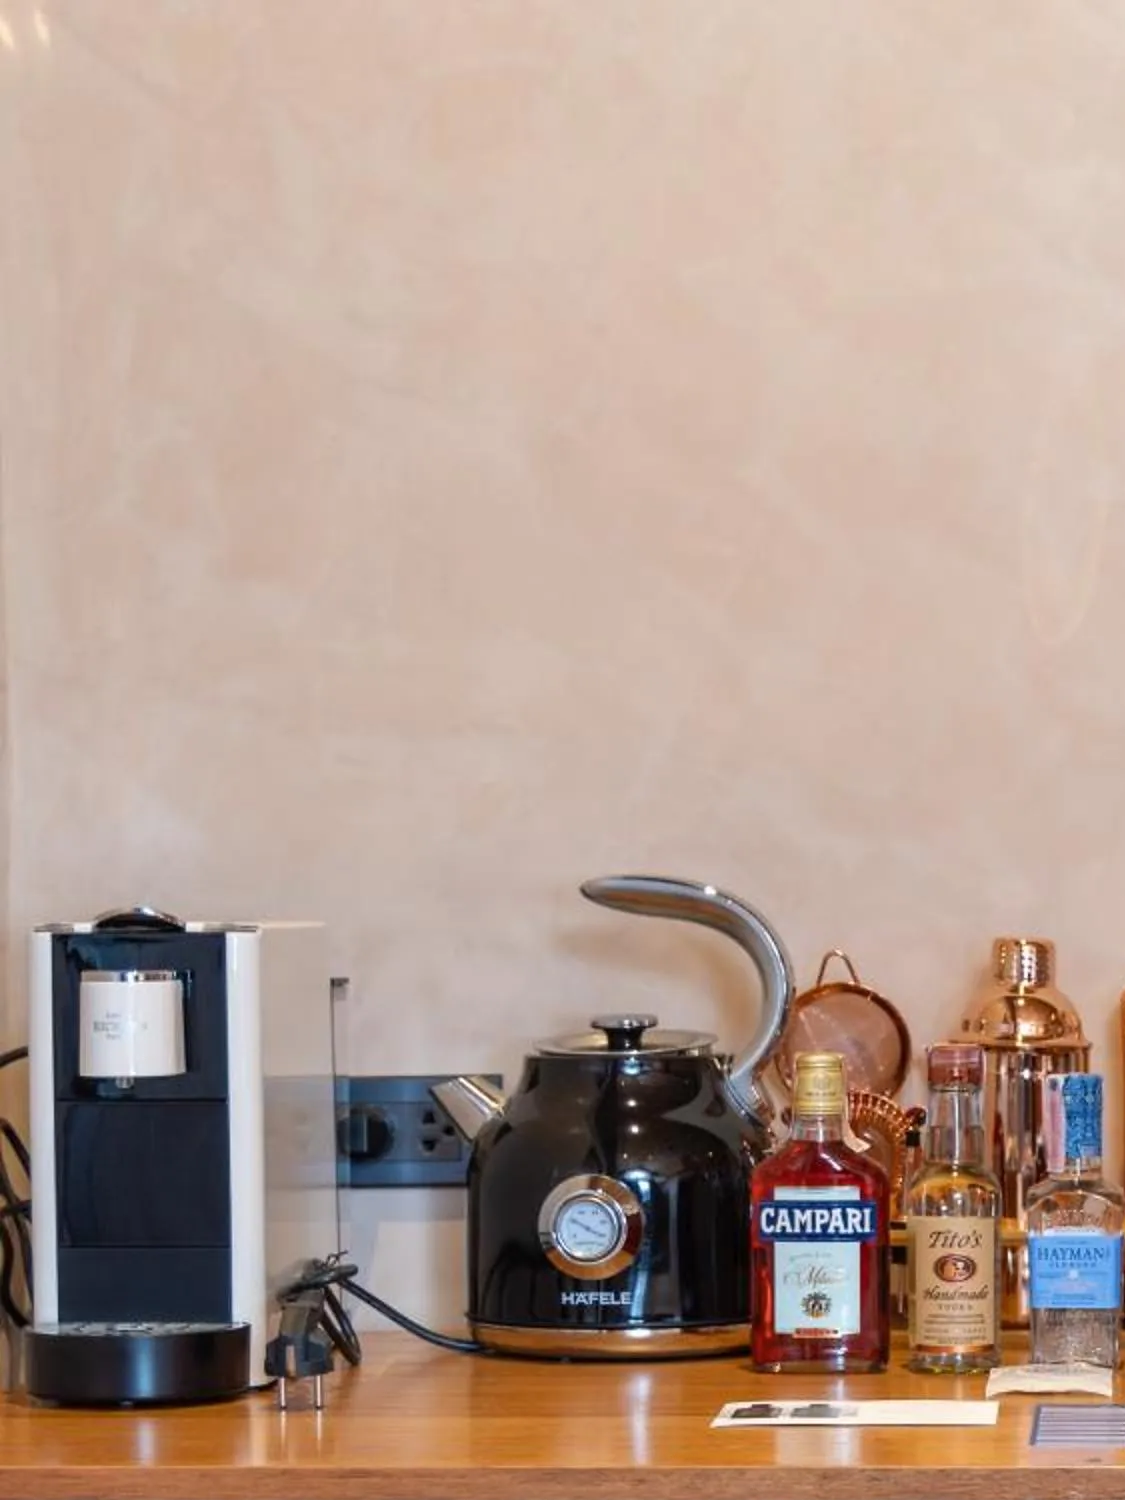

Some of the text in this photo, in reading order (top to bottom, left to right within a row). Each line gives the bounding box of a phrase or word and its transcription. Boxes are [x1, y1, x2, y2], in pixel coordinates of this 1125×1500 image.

[760, 1207, 872, 1234] CAMPARI
[928, 1229, 983, 1249] Tito's
[560, 1291, 632, 1305] HÄFELE
